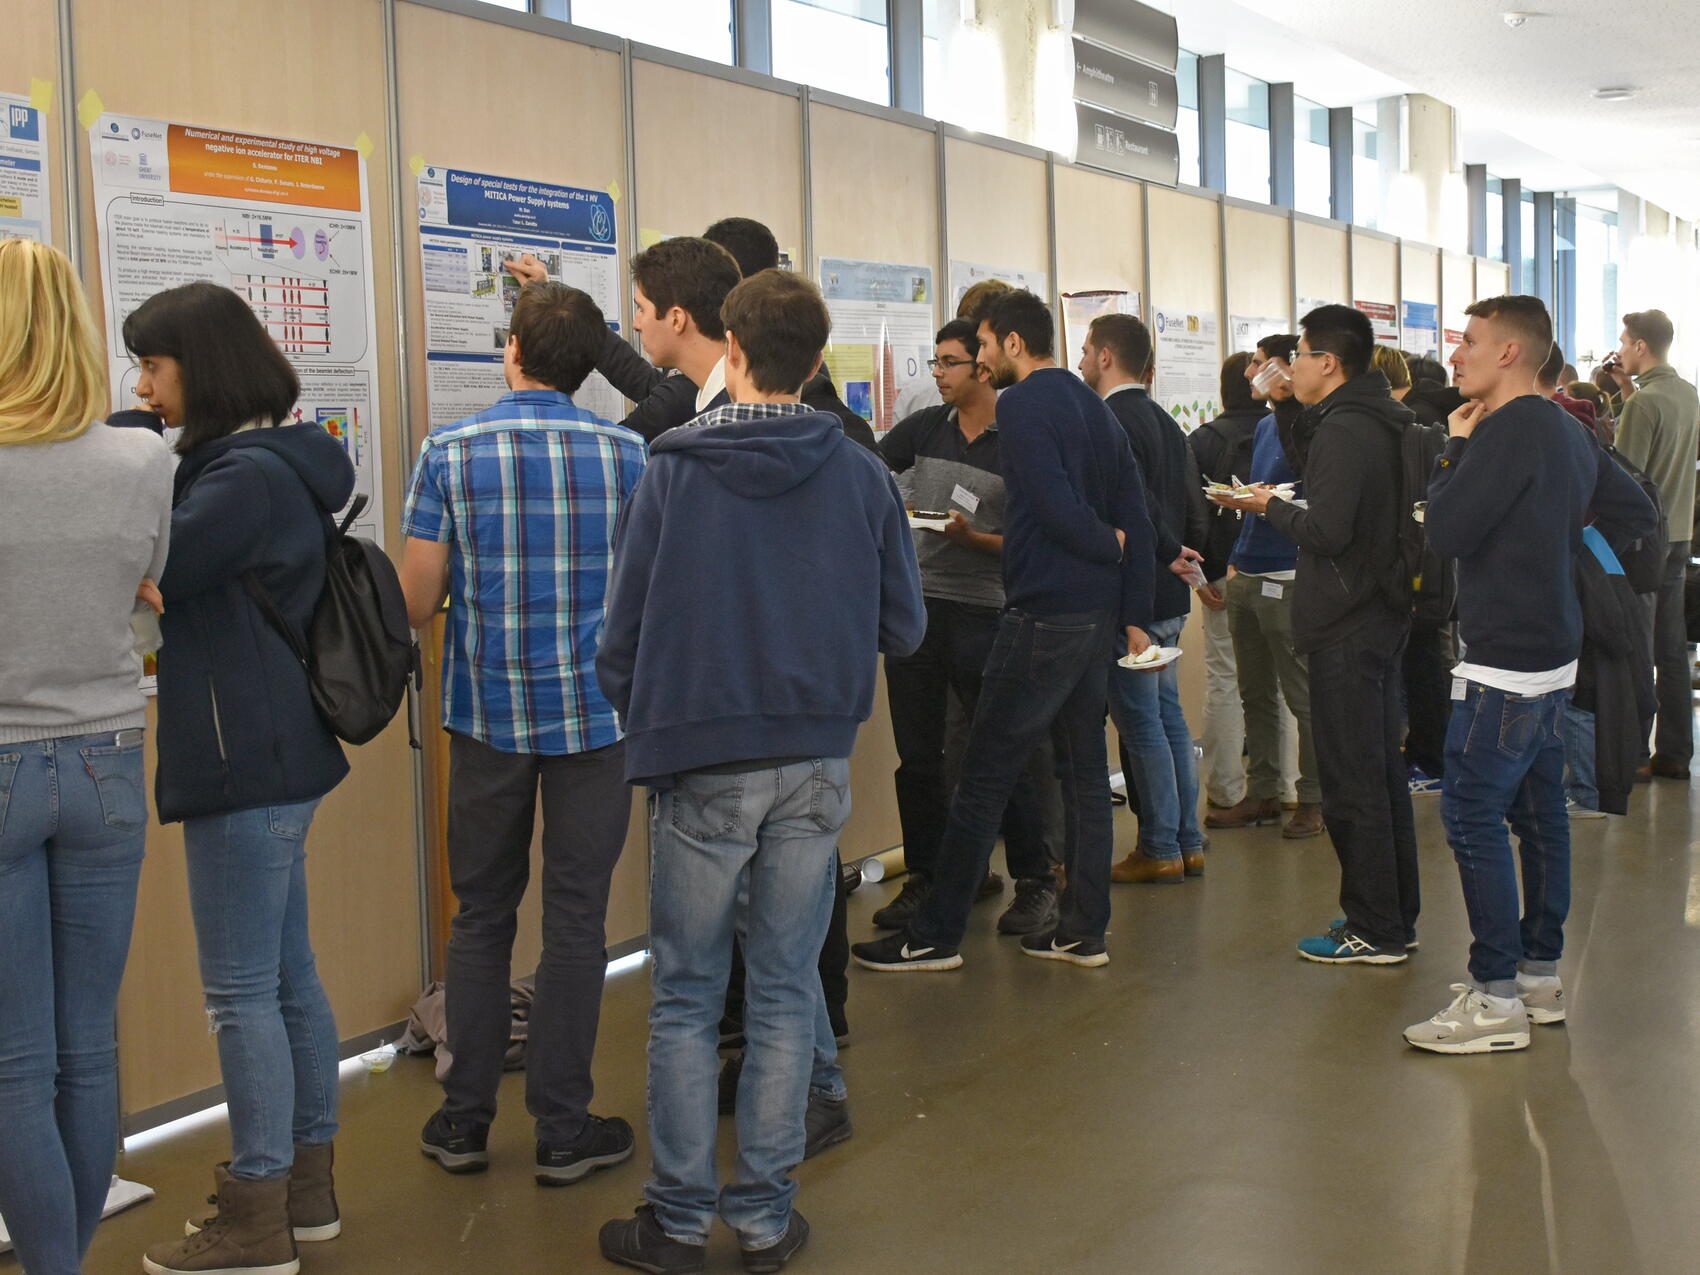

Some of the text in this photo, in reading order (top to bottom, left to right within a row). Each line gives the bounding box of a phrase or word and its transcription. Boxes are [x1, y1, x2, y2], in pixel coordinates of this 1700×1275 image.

[11, 106, 28, 128] IPP
[184, 127, 341, 158] Numerical and experimental study of high voltage
[205, 143, 323, 165] negative ion accelerator for ITER NBI
[450, 173, 599, 203] Design of special tests for the integration of the 1 MV
[484, 190, 570, 210] MITICA Power Supply systems
